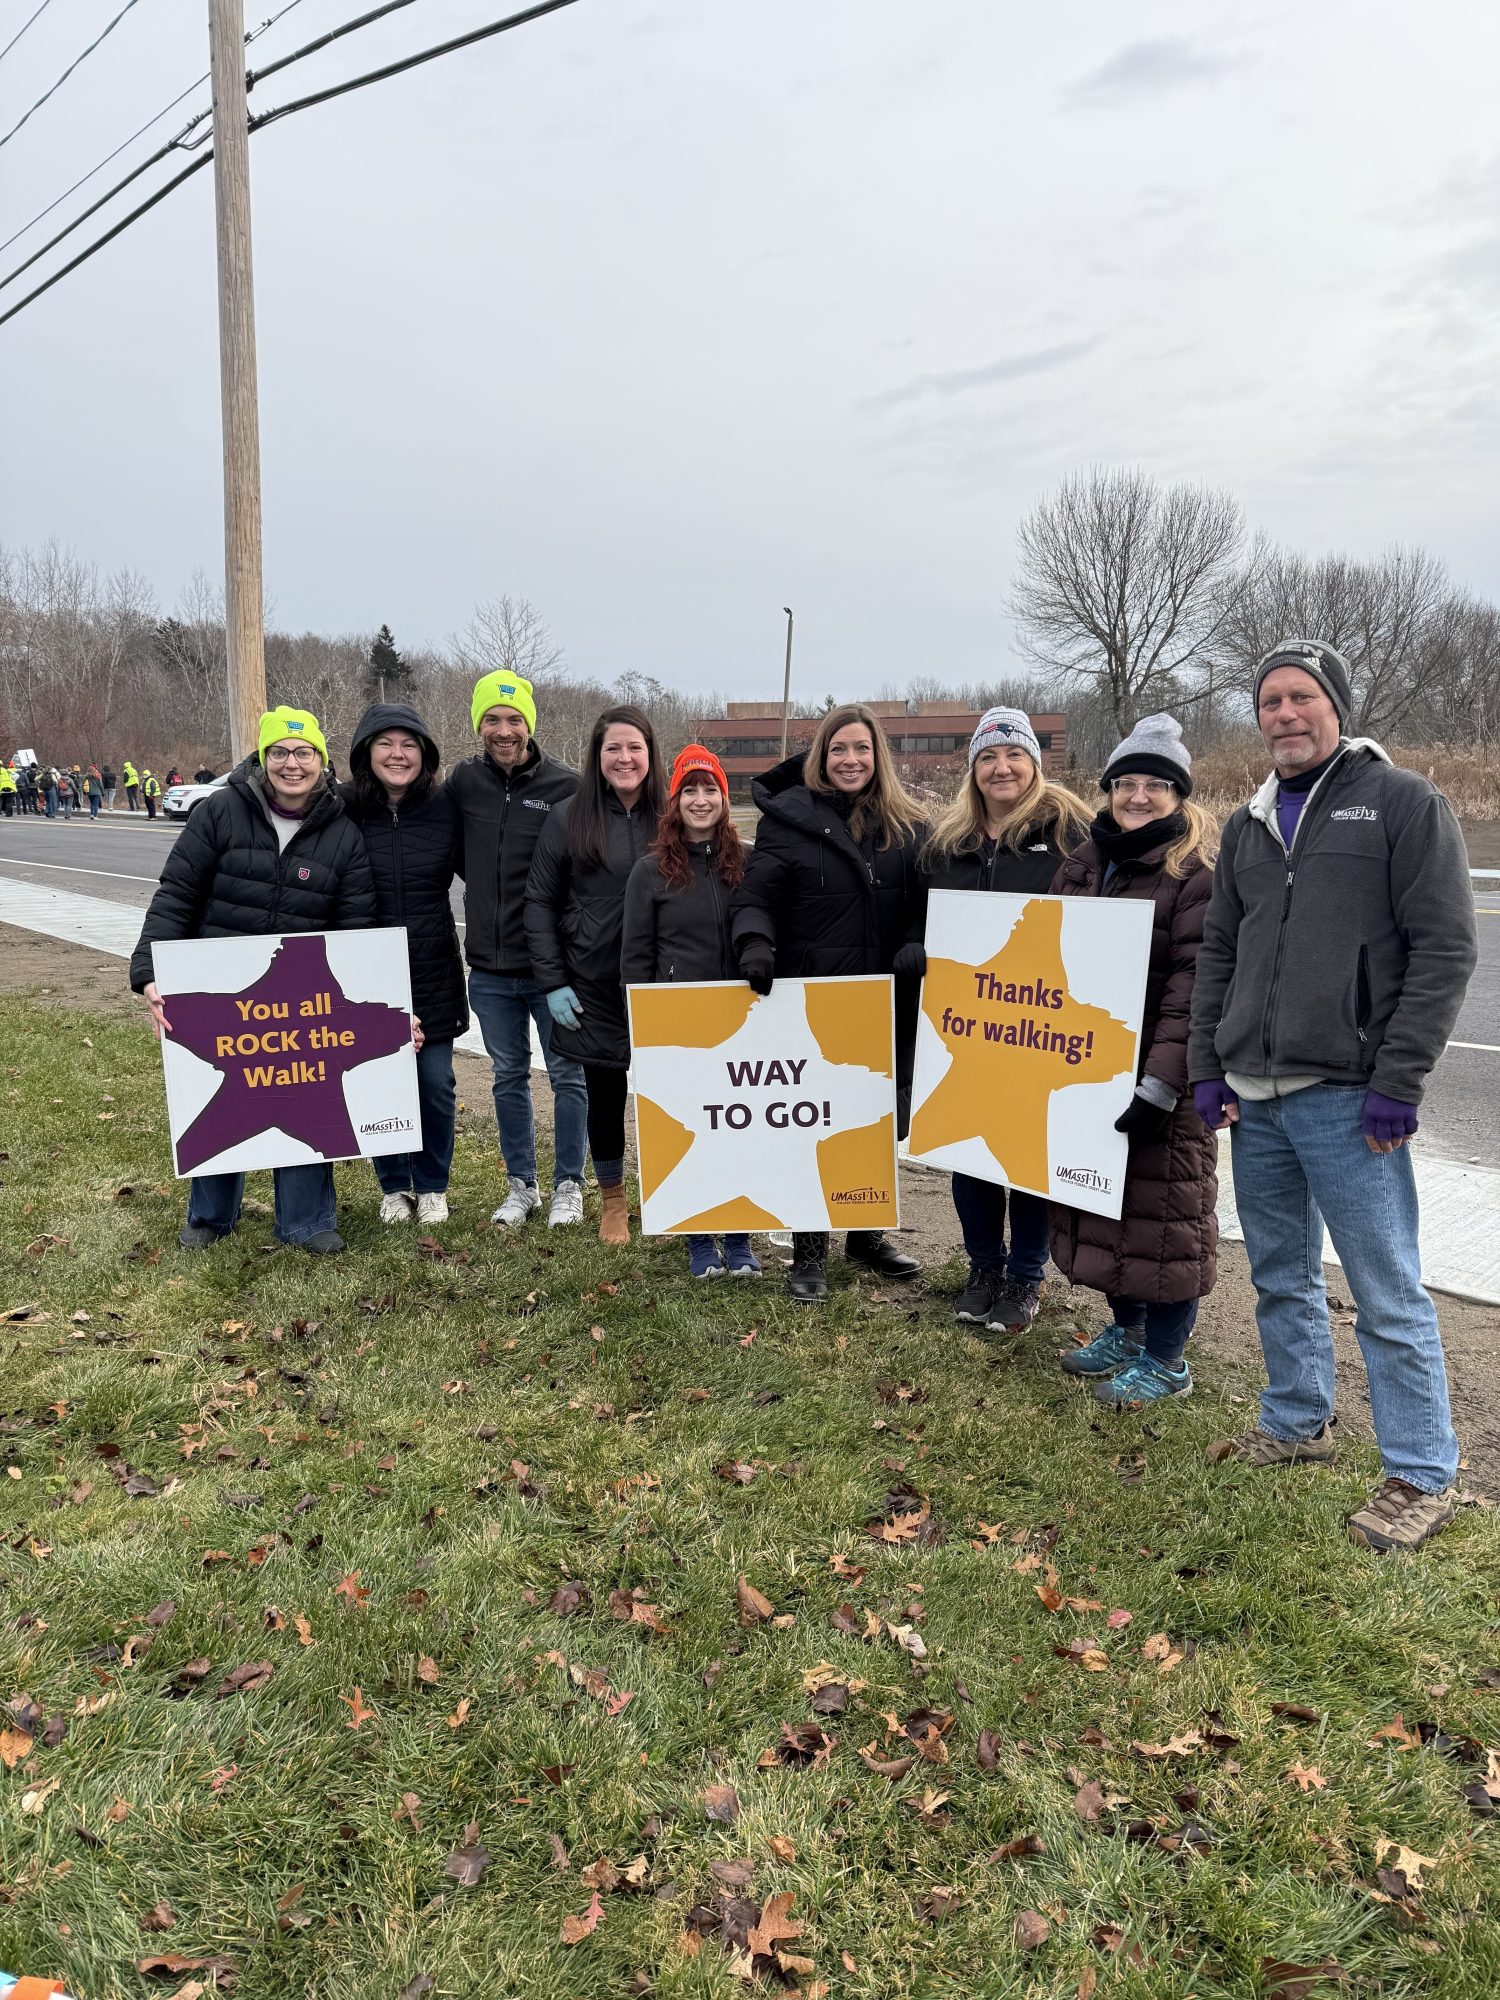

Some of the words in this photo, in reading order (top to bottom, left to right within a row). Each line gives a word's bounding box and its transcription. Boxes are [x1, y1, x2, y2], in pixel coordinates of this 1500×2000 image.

[975, 973, 1064, 1010] Thanks
[235, 999, 290, 1021] You
[299, 993, 332, 1017] all
[216, 1030, 301, 1057] ROCK
[309, 1026, 356, 1049] the
[942, 1008, 976, 1037] for
[983, 1019, 1094, 1065] walking!
[243, 1061, 326, 1088] Walk!
[726, 1059, 808, 1087] WAY
[703, 1103, 752, 1130] TO
[765, 1101, 832, 1129] GO!
